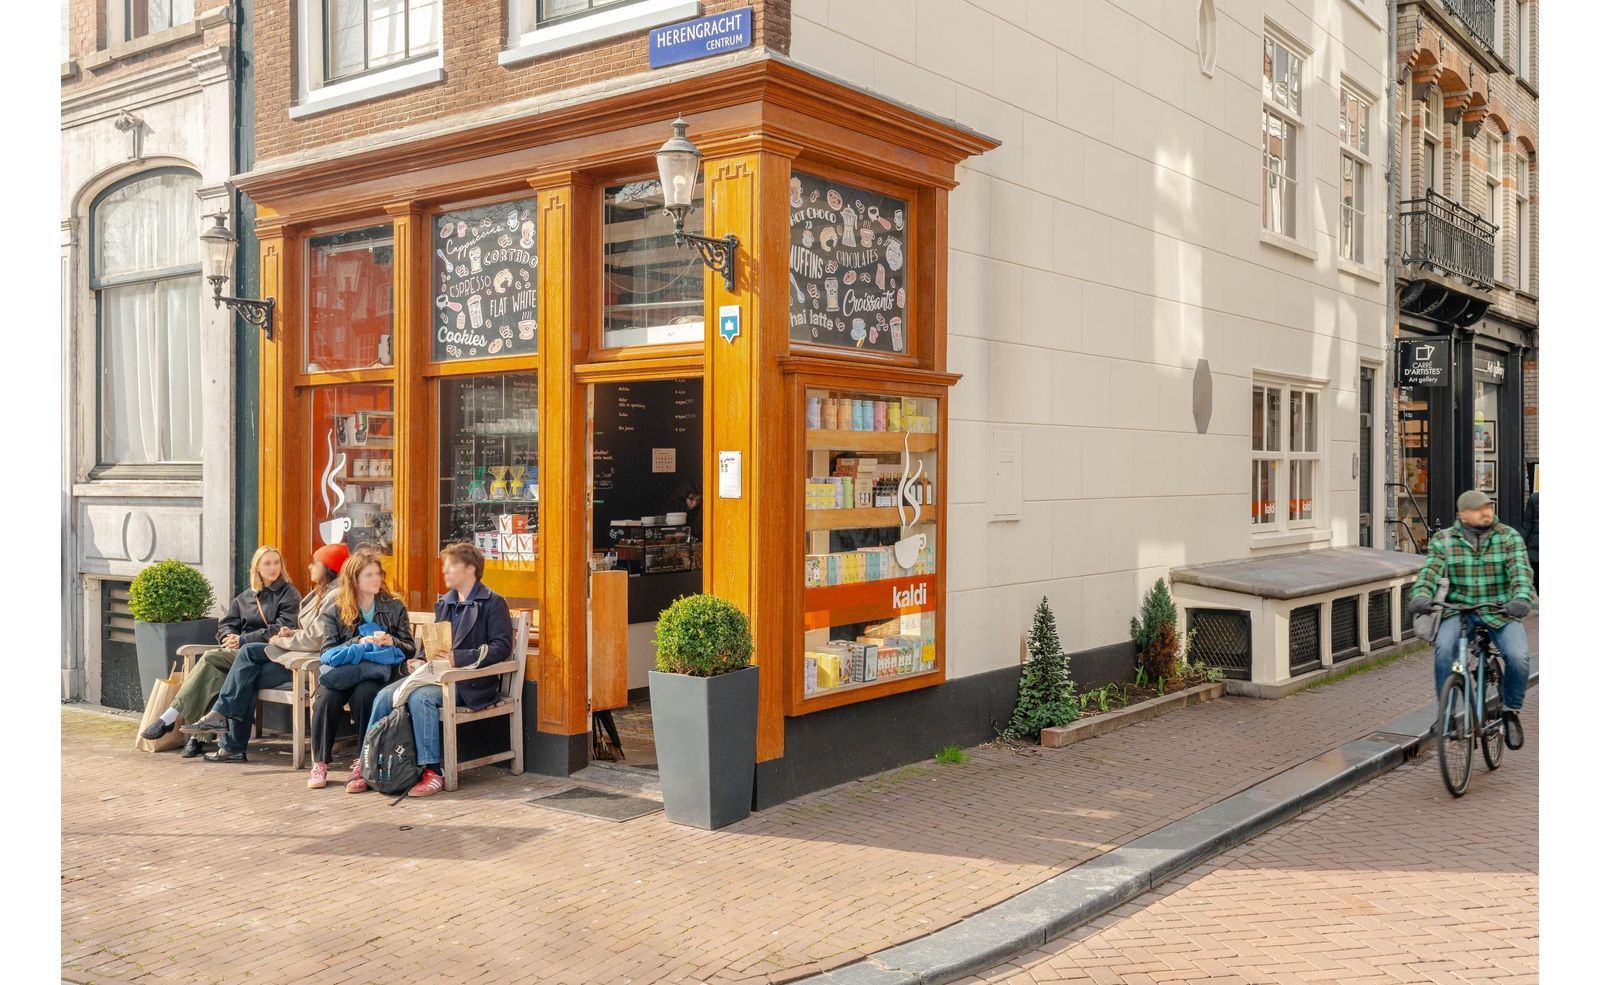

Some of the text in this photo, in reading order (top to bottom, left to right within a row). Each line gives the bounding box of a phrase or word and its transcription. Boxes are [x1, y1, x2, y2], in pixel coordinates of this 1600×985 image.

[657, 14, 742, 48] HERENGRACHT
[706, 33, 743, 51] CENTRUM
[790, 207, 837, 227] HOT CHOCO
[483, 248, 539, 268] CORTADO
[836, 248, 879, 269] CHOCOLATES
[450, 275, 491, 298] ESPRESSO
[490, 289, 537, 318] FLAT WHITE
[842, 288, 896, 317] Croissants
[790, 309, 834, 331] hai latte
[437, 326, 488, 347] Cookies
[1412, 361, 1433, 369] CARRÉ
[1418, 376, 1438, 384] gallery
[892, 582, 927, 609] kaldi
